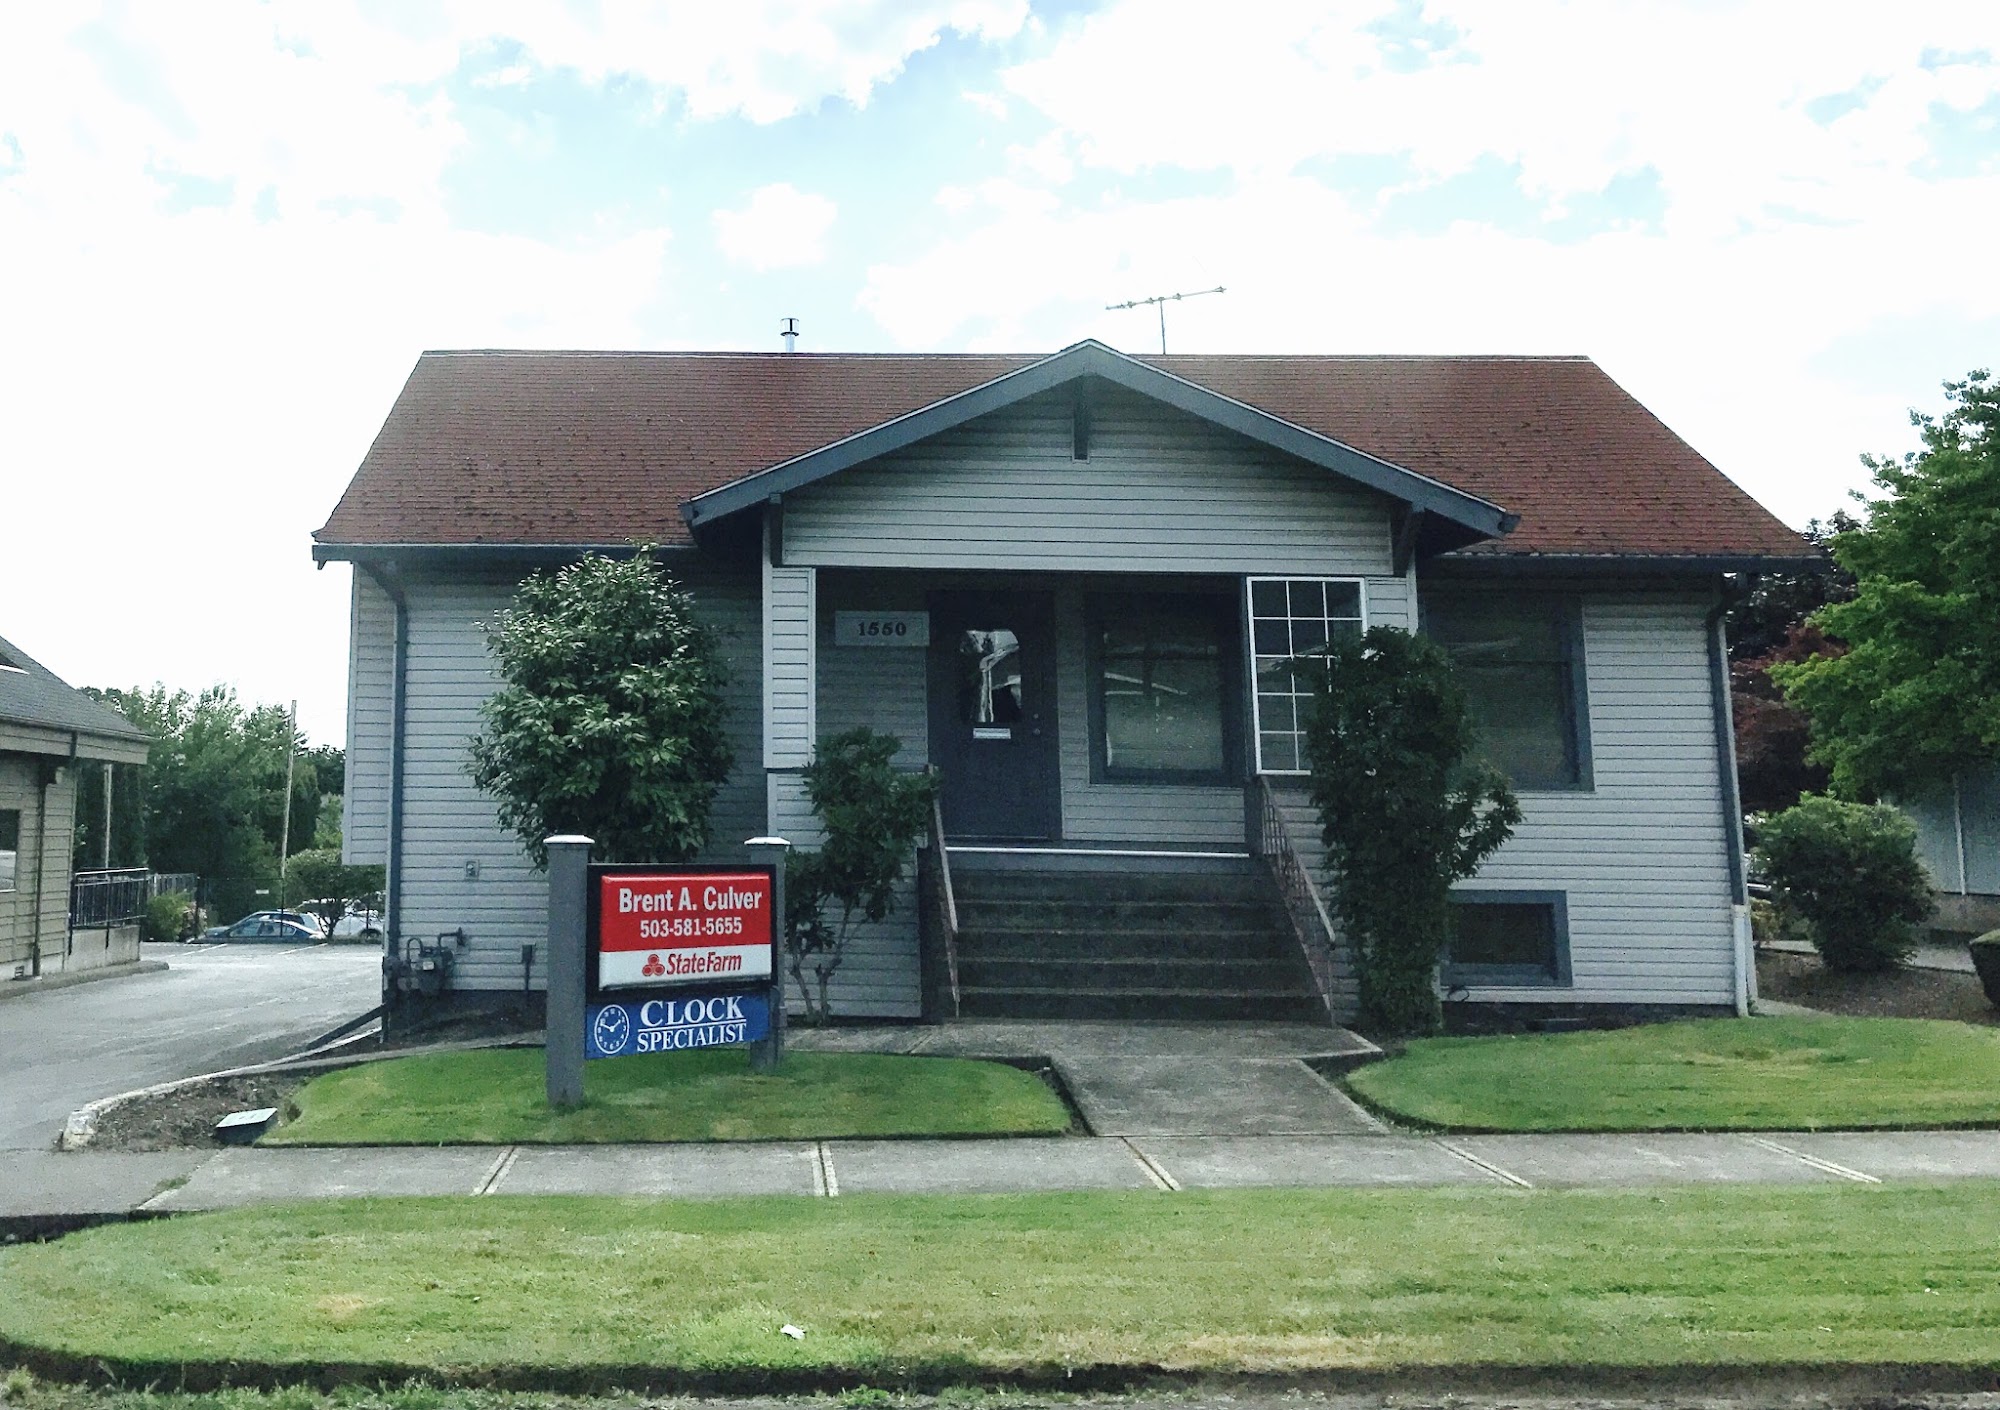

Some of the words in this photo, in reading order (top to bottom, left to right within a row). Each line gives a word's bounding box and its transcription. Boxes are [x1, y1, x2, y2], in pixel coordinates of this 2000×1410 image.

[858, 621, 907, 636] 1550
[619, 887, 674, 913] Brent
[678, 886, 698, 911] A.
[703, 885, 763, 910] Culver
[640, 916, 742, 938] 503-581-5655
[640, 995, 745, 1027] CLOCK
[637, 1022, 747, 1052] SPECIALIST
